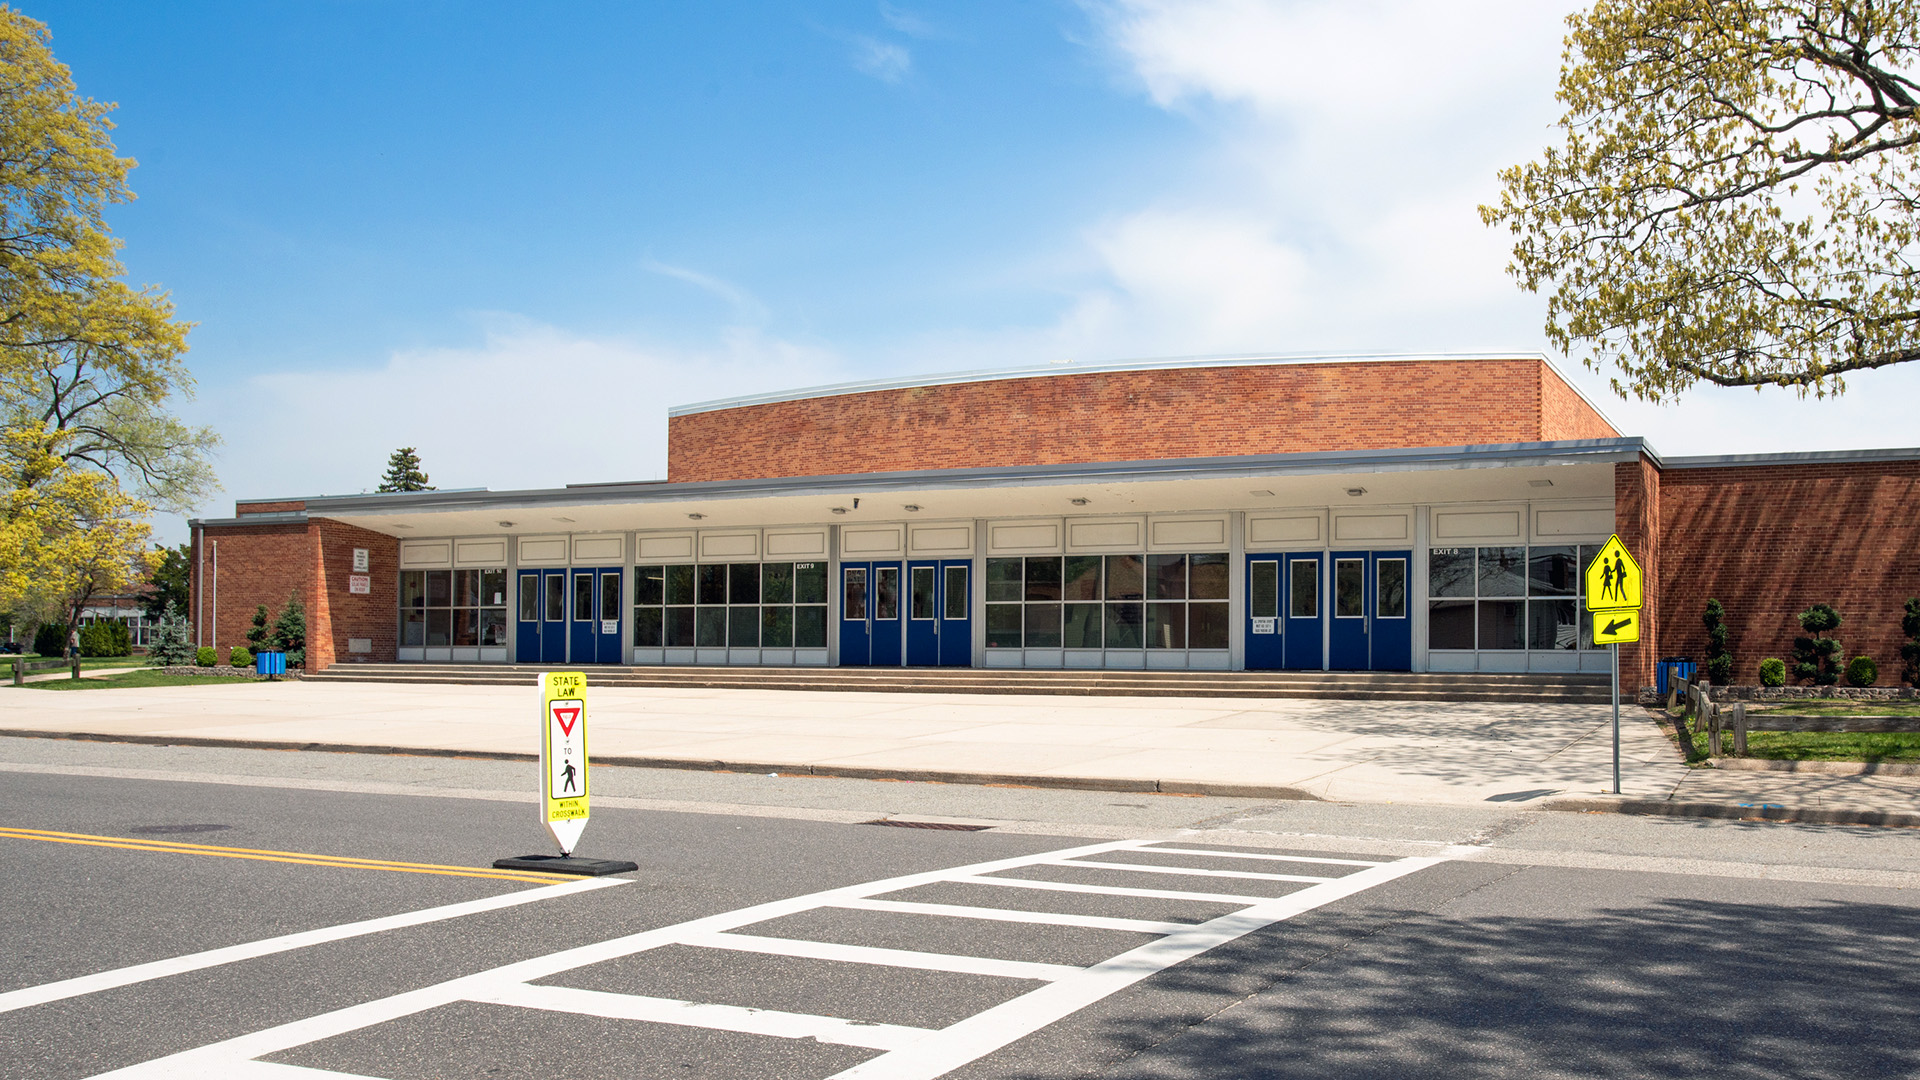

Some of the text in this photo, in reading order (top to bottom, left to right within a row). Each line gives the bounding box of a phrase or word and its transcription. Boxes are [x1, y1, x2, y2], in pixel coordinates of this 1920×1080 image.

[553, 677, 579, 686] STATE
[557, 687, 575, 697] LAW
[564, 747, 572, 755] TO
[559, 800, 578, 808] WITHIN
[552, 809, 585, 818] CROSSWALK
